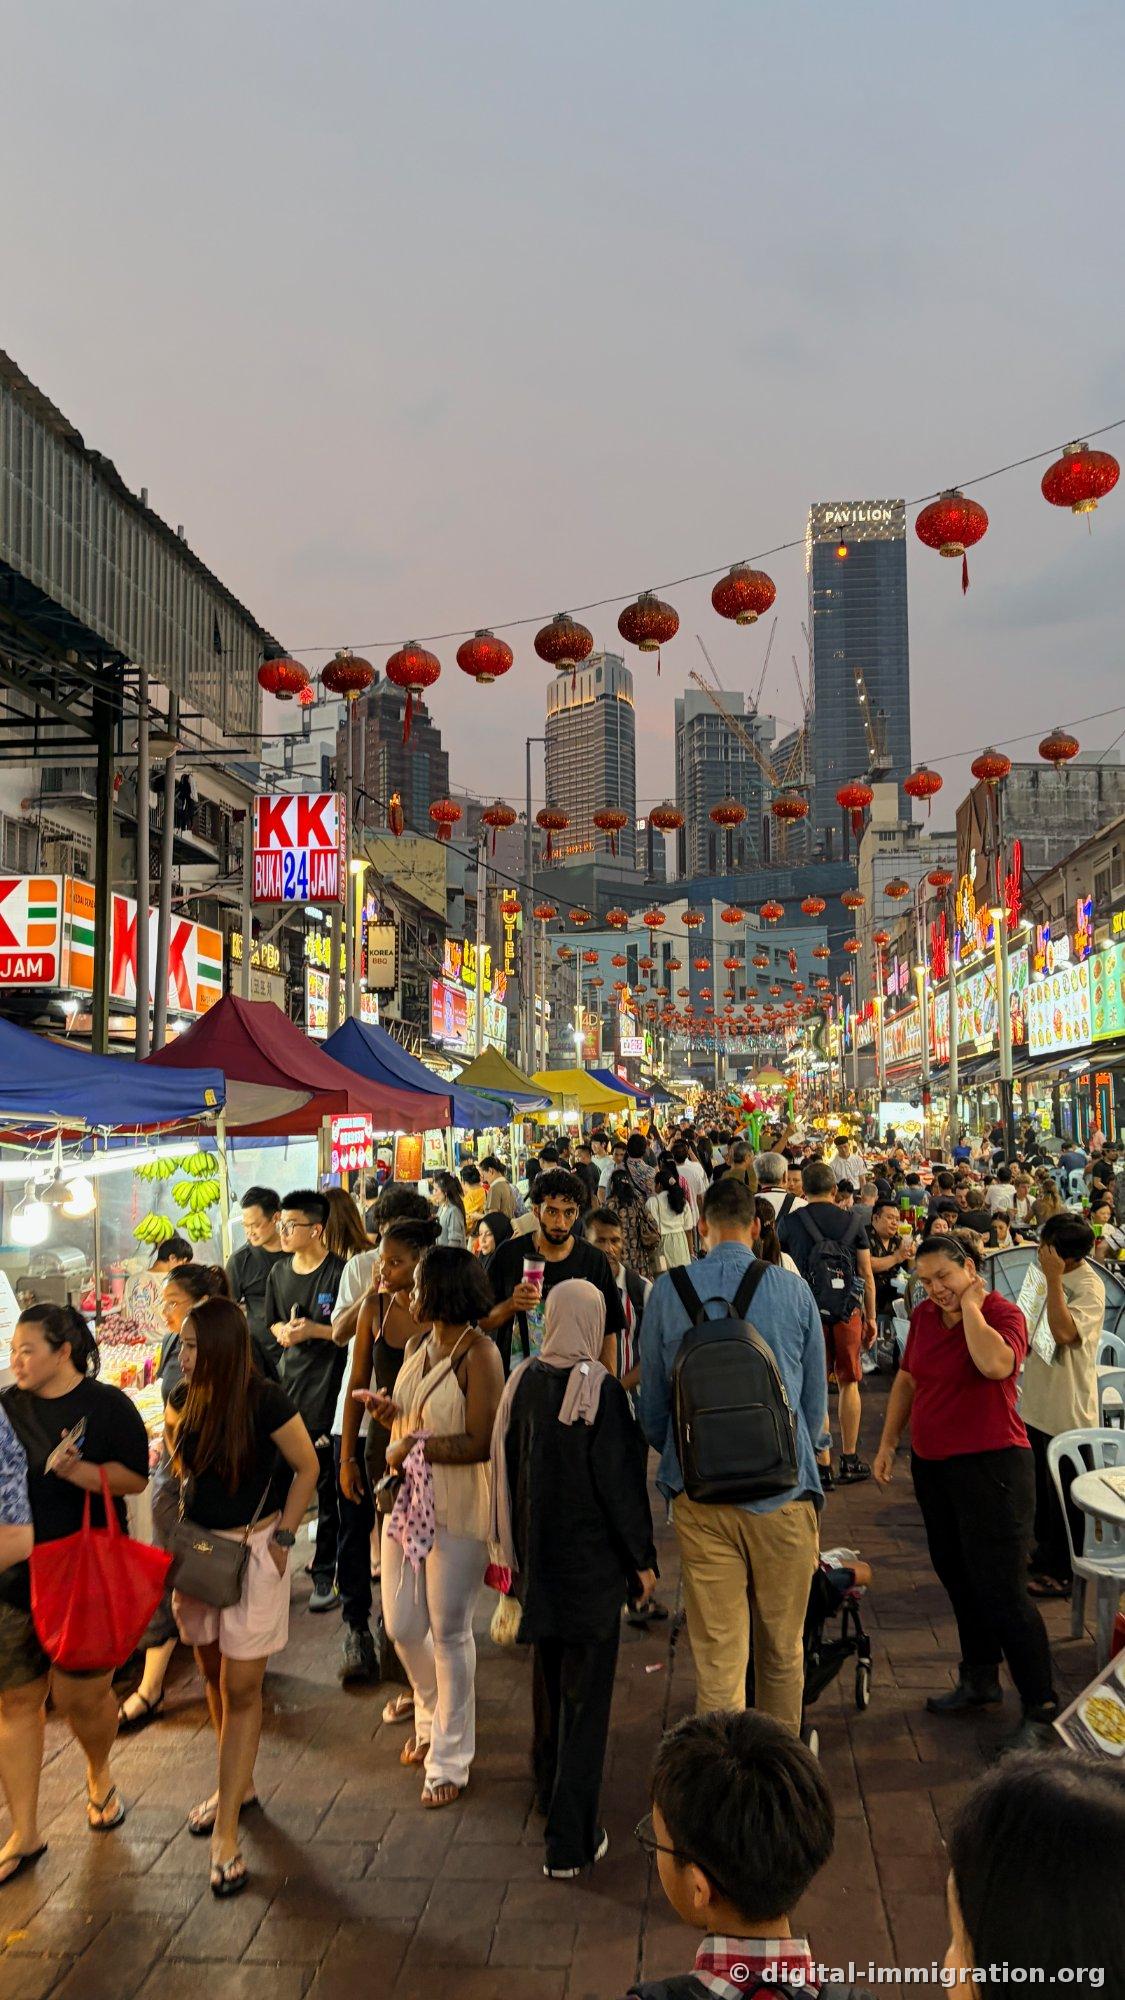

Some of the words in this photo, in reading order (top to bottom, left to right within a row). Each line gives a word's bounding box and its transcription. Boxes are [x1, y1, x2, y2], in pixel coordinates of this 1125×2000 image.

[825, 509, 892, 523] PAVILION
[259, 795, 334, 848] KK
[255, 854, 282, 898] BUKA
[284, 851, 308, 899] 24
[311, 853, 338, 896] JAM
[0, 957, 43, 978] JAM
